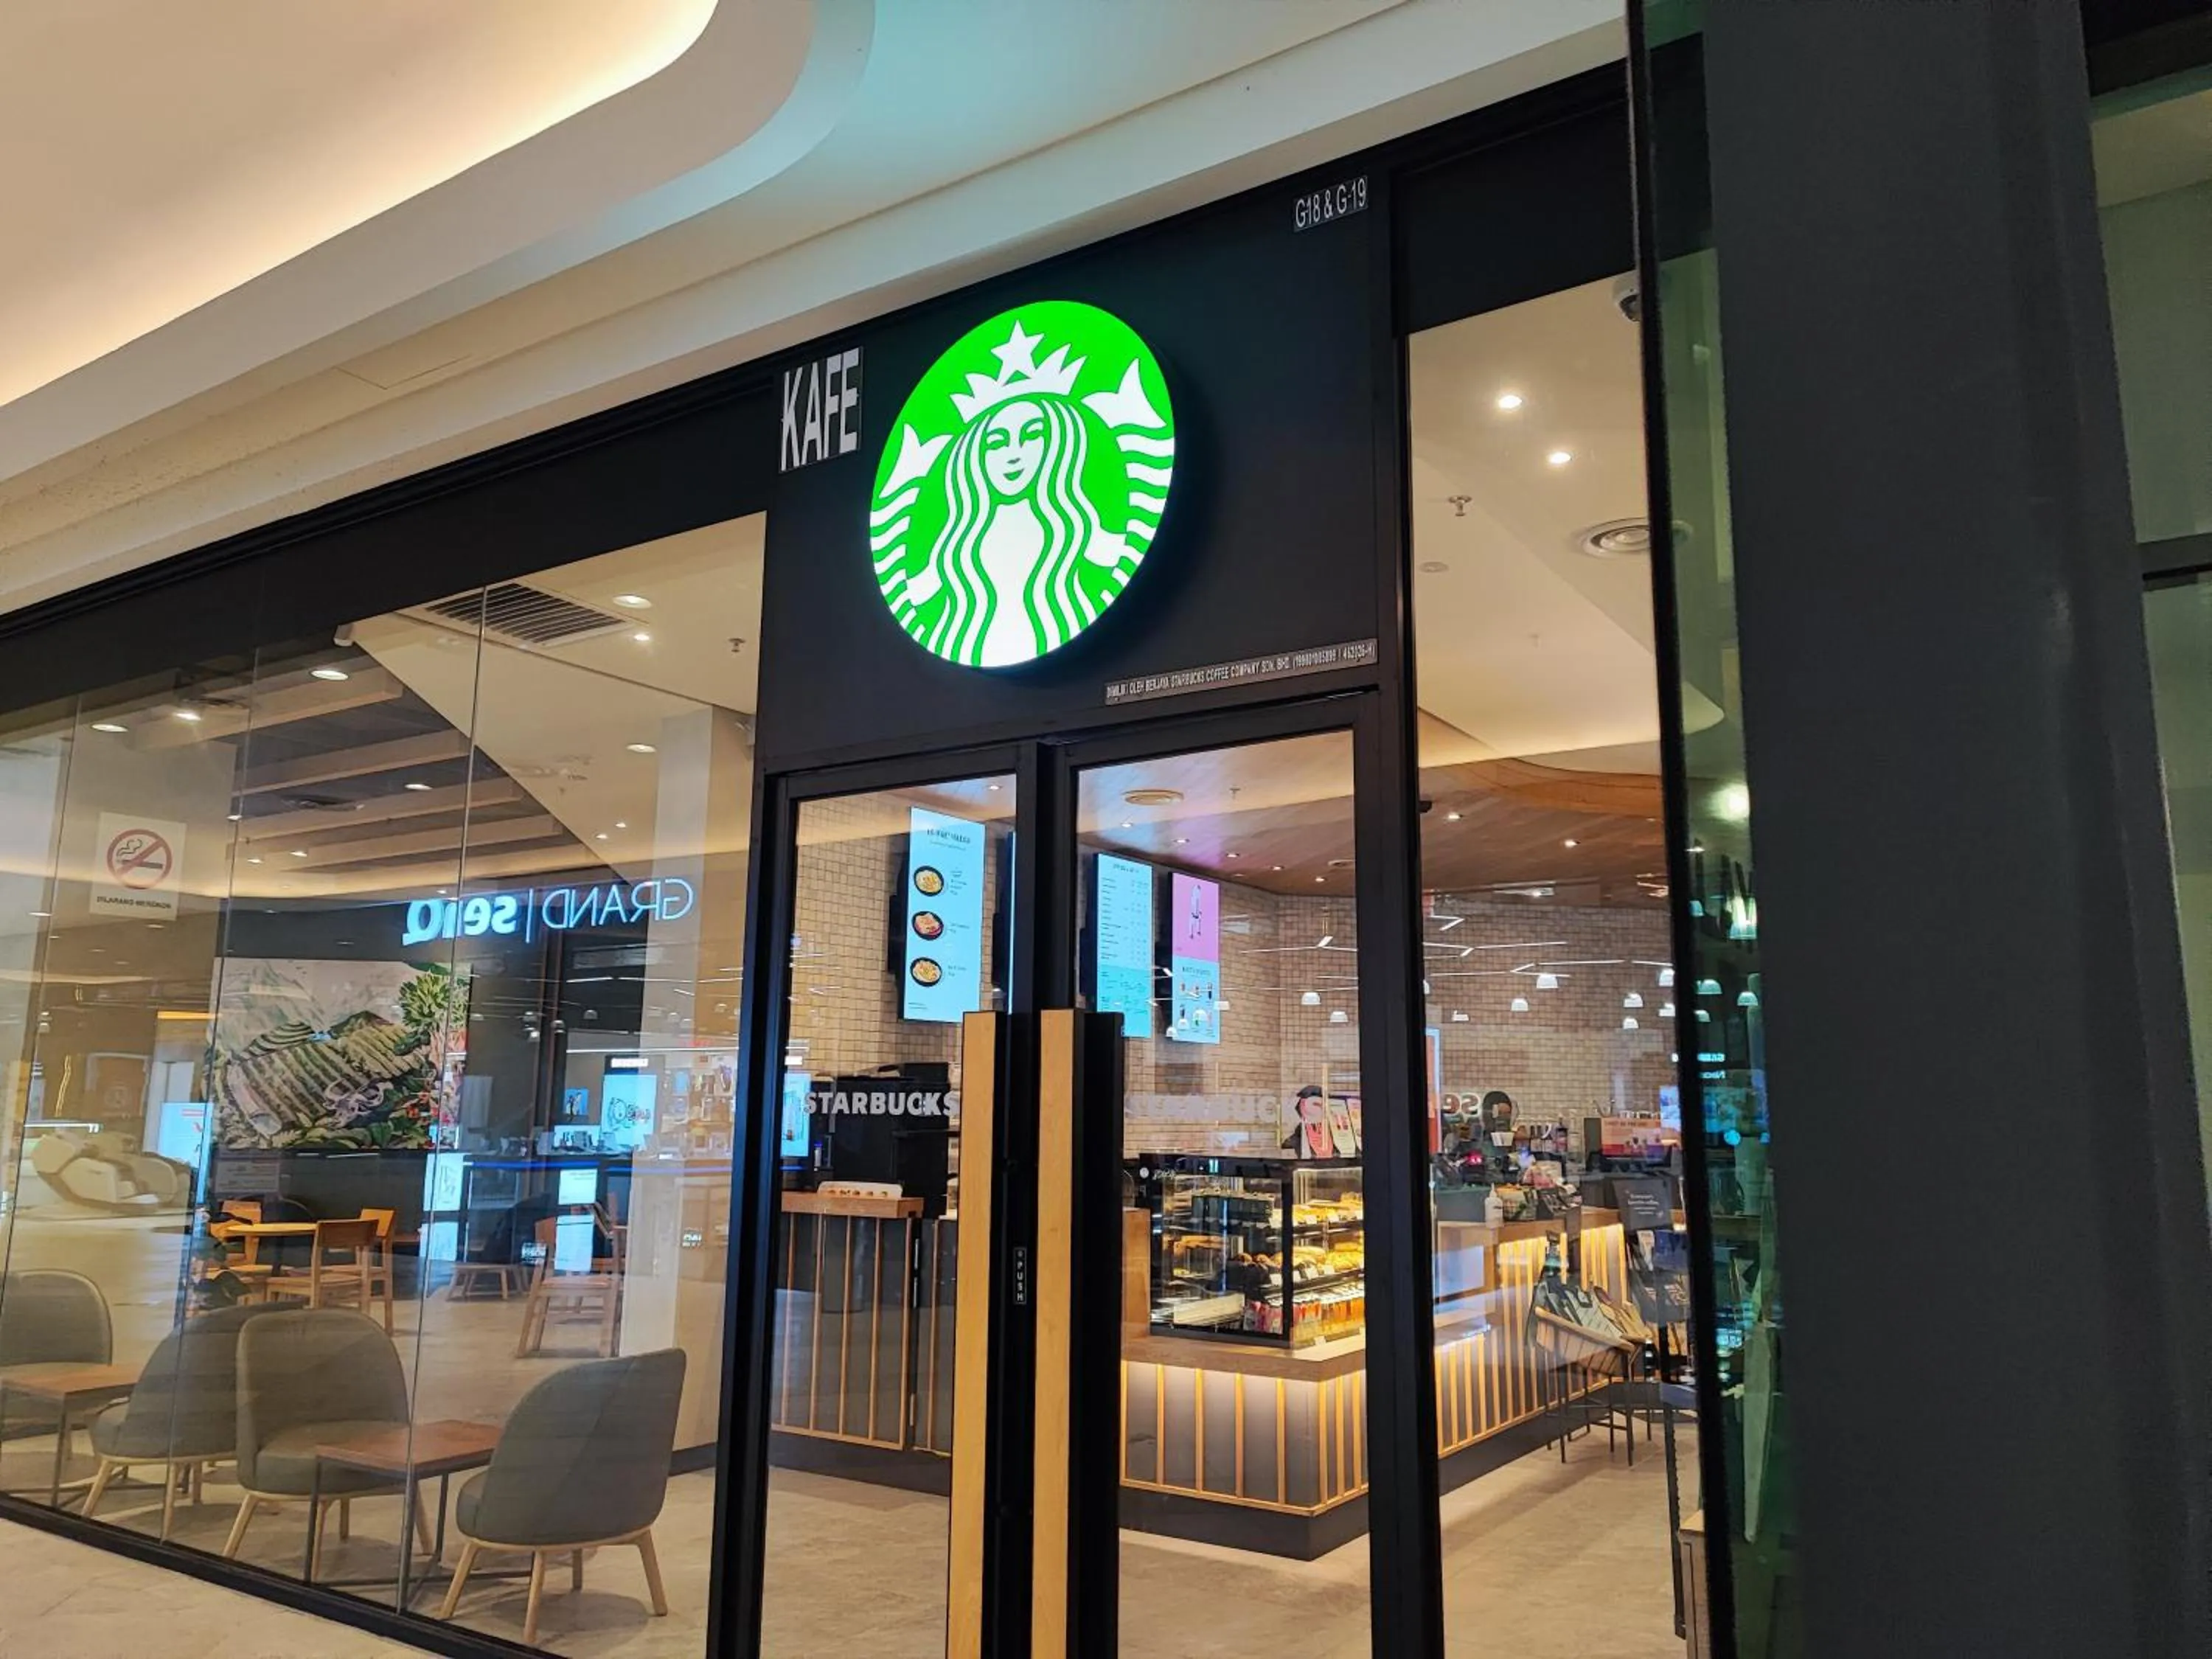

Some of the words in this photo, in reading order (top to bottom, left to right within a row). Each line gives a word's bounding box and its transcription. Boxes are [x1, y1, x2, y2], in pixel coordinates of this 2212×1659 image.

[1324, 189, 1333, 219] &
[1337, 178, 1366, 215] G-19
[781, 347, 859, 472] KAFE
[1170, 671, 1205, 688] STARBUCKS
[1206, 667, 1228, 682] COFFEE
[804, 1091, 961, 1116] STARBUCKS
